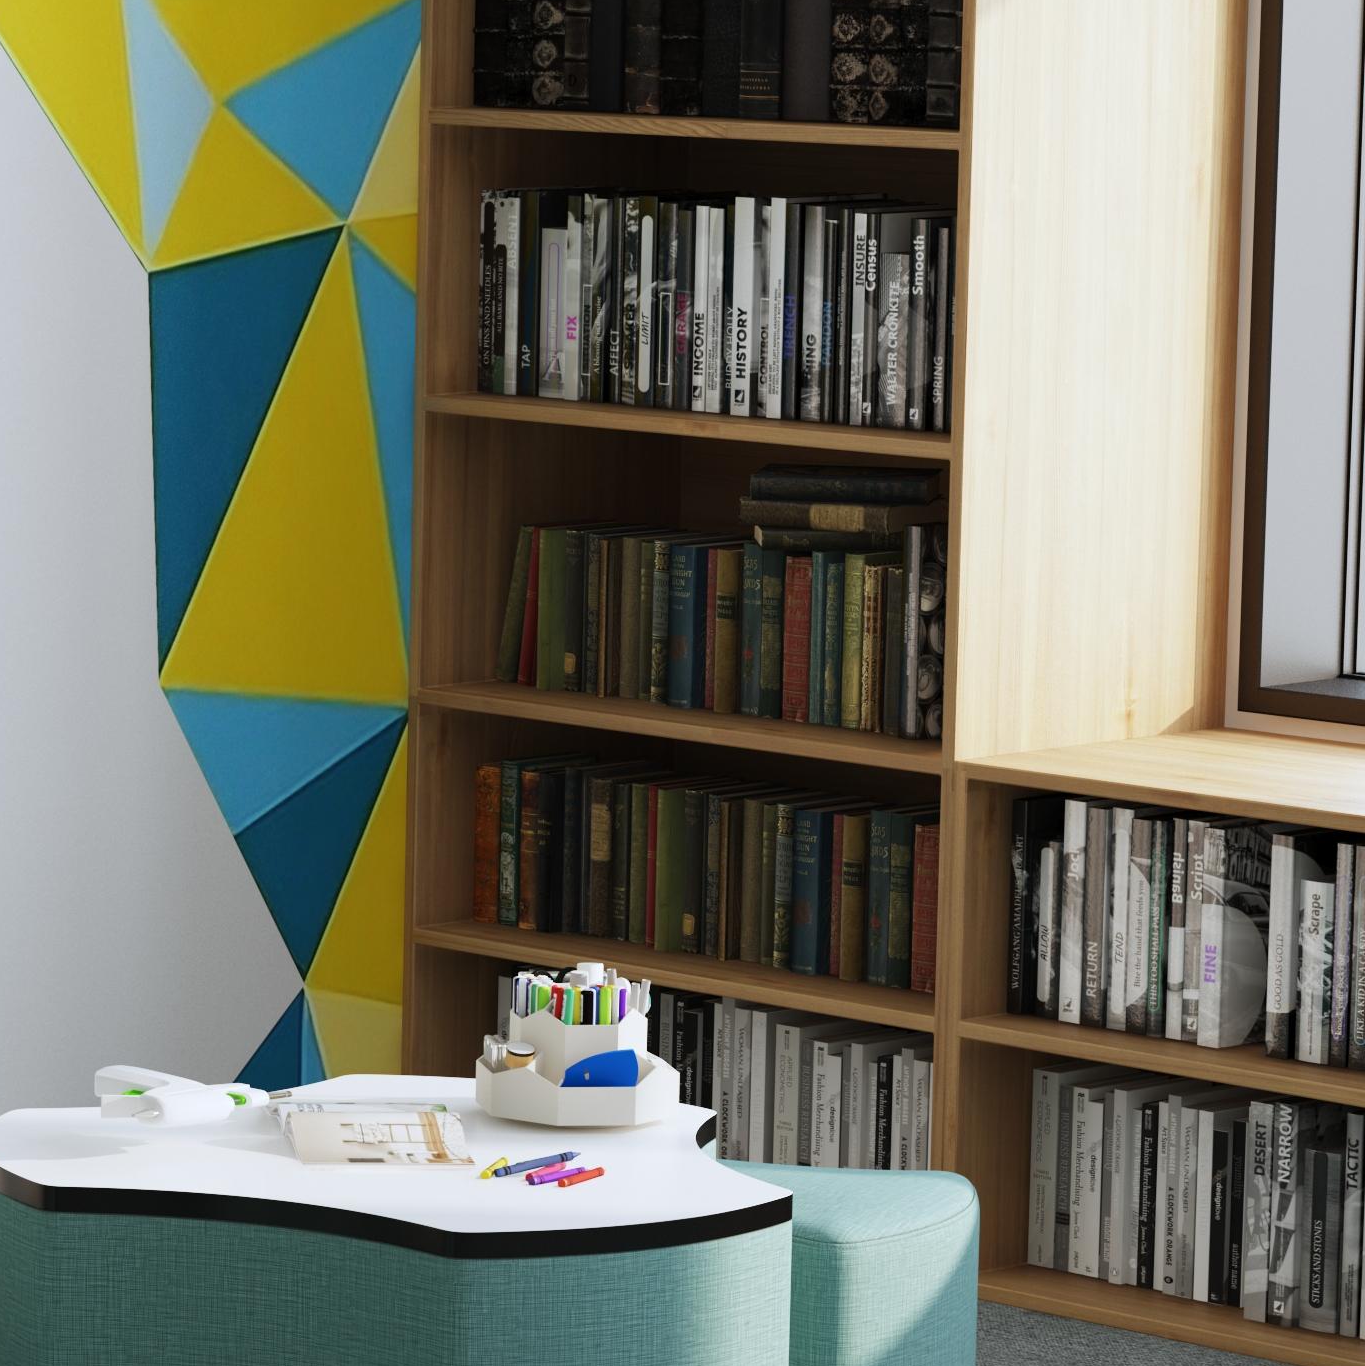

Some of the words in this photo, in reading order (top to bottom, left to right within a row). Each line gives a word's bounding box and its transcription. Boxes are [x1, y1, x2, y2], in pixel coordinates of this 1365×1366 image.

[507, 214, 518, 269] ABSENT
[855, 235, 866, 286] INSURE
[866, 238, 877, 292] Census
[913, 235, 925, 295] Smooth
[484, 264, 493, 306] NEEDLES
[484, 306, 492, 326] AND
[566, 315, 577, 341] FIX
[642, 313, 651, 346] LIMIT
[888, 281, 900, 349] CRONKITE
[483, 327, 492, 348] PINS
[694, 313, 705, 376] INCOME
[735, 307, 748, 380] HISTORY
[822, 300, 832, 366] PARDON
[483, 350, 491, 365] ON
[521, 344, 531, 369] TAP
[609, 329, 620, 376] AFFECT
[759, 323, 769, 385] CONTROL
[885, 351, 898, 405] WALTER
[933, 356, 943, 404] SPRING
[1191, 853, 1204, 901] Script
[1136, 897, 1145, 917] feeds
[1152, 905, 1160, 927] PASS
[1309, 893, 1322, 936] Scrape
[1040, 924, 1049, 961] ALLOW
[1135, 918, 1144, 936] that
[1115, 932, 1124, 964] TEND
[1135, 938, 1143, 956] hand
[1151, 929, 1159, 958] SHALL
[1276, 934, 1284, 963] GOLD
[1011, 931, 1021, 990] WOLFGANG
[1086, 941, 1098, 998] RETURN
[1134, 957, 1142, 970] the
[1150, 960, 1158, 982] TOO
[1204, 945, 1217, 983] FINE
[1275, 964, 1283, 977] AS
[1133, 972, 1142, 988] Bite
[1150, 985, 1158, 1007] THIS
[1274, 978, 1282, 1010] GOOD
[1358, 976, 1365, 987] IN
[1357, 988, 1365, 1007] KID
[1357, 1009, 1364, 1017] A
[1356, 1017, 1364, 1040] LIKE
[817, 1073, 825, 1101] Fashion
[879, 1089, 888, 1116] Fashion
[721, 1098, 729, 1143] CLOCKWORK
[813, 1103, 824, 1156] Merchandising
[1076, 1120, 1085, 1149] Fashion
[1144, 1136, 1153, 1165] Fashion
[1184, 1125, 1192, 1162] WOMAN
[1254, 1120, 1267, 1176] DESERT
[1277, 1103, 1293, 1183] NARROW
[1072, 1151, 1084, 1207] Merchandising
[1346, 1138, 1359, 1190] TACTIC
[1139, 1167, 1152, 1222] Merchandising
[1182, 1164, 1190, 1213] UNLEASHED
[1166, 1194, 1174, 1237] CLOCKWORK
[1314, 1219, 1322, 1252] STONES
[1165, 1239, 1173, 1266] ORANGE
[1231, 1243, 1240, 1269] author
[1313, 1253, 1321, 1272] AND
[1231, 1270, 1239, 1290] name
[1312, 1273, 1320, 1304] STICKS
